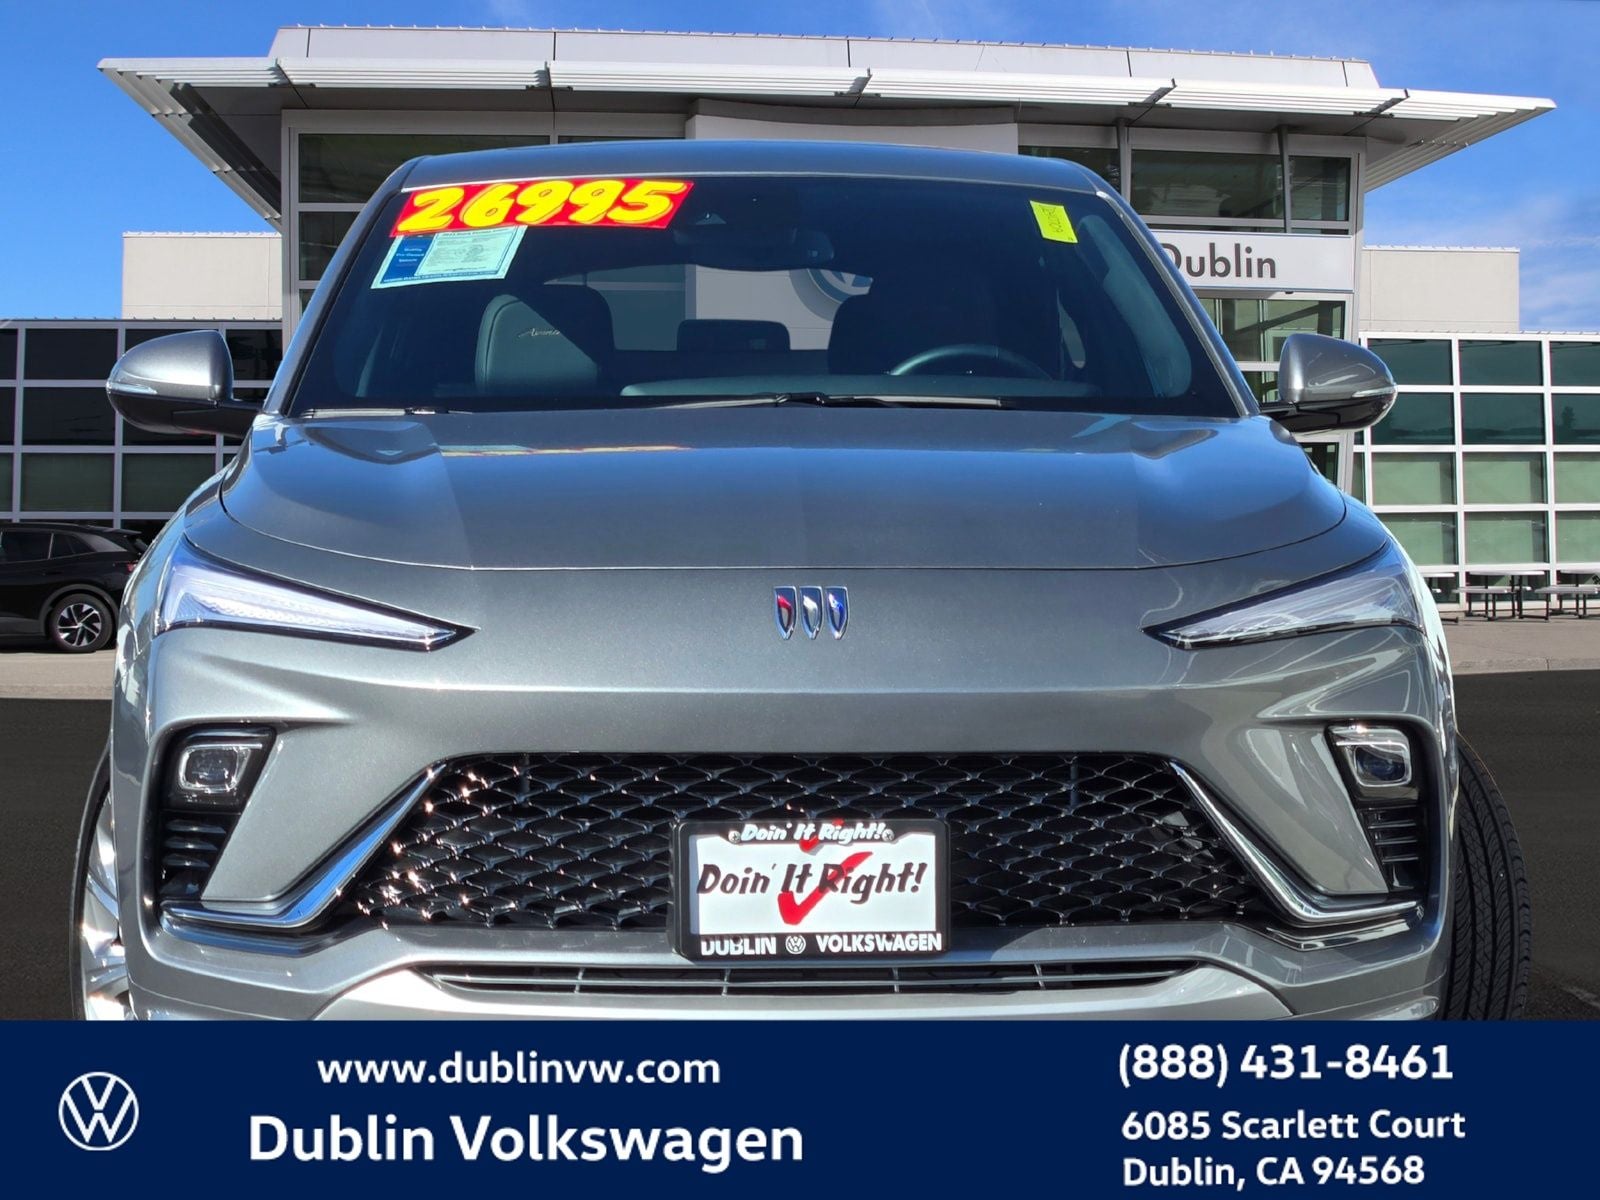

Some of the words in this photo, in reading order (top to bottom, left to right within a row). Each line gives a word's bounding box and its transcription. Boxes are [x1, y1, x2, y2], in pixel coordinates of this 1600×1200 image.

[397, 180, 687, 231] 26995
[740, 822, 793, 841] Doin'
[793, 823, 816, 841] It
[818, 822, 886, 845] Right!
[697, 863, 777, 894] Doin'
[781, 863, 812, 893] It
[819, 862, 928, 904] Right!
[701, 935, 777, 956] DUBLIN
[816, 933, 942, 953] VOLKSWAGEN
